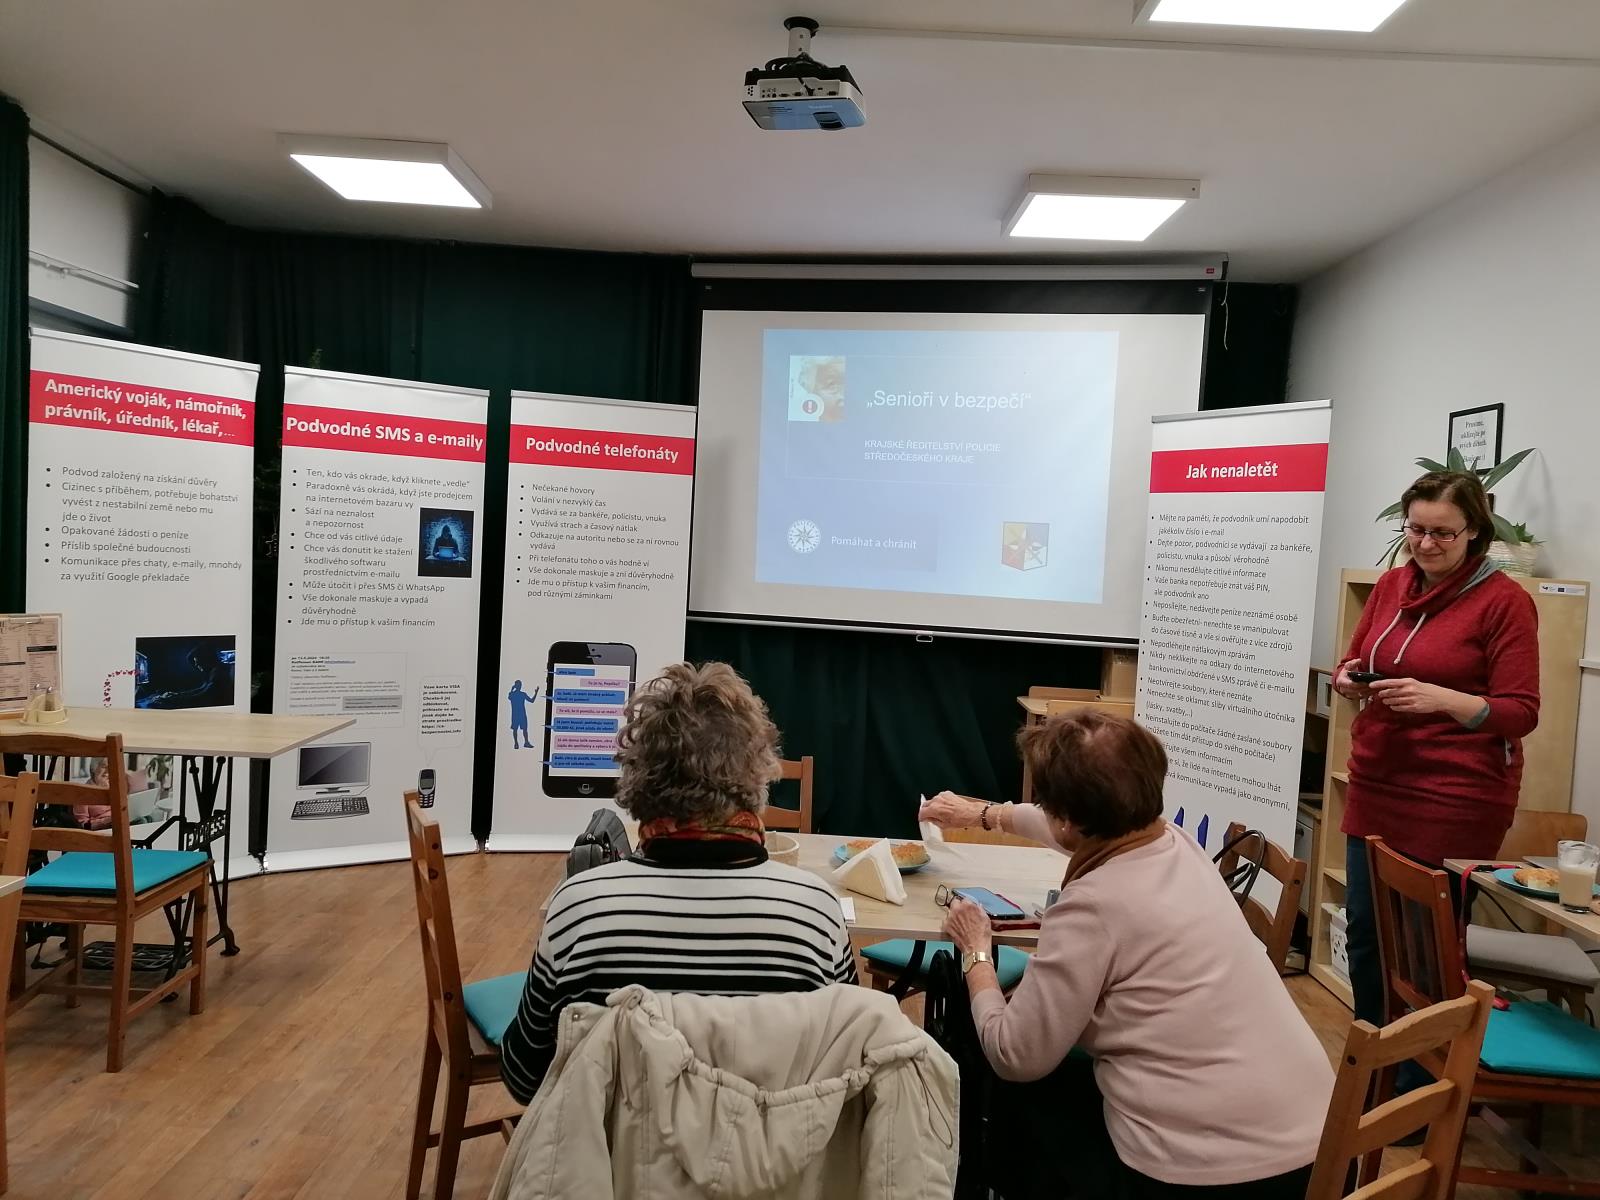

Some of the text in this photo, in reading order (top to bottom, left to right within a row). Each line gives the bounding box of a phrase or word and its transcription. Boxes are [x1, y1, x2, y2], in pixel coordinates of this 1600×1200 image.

[45, 379, 247, 419] Americký voják, námořník,
[940, 396, 949, 407] v
[45, 405, 111, 423] právník,
[116, 412, 178, 432] úředník,
[287, 417, 483, 451] Podvodné SMS a e-maily
[526, 437, 679, 463] Podvodné telefonáty
[865, 439, 1001, 452] KRAJSKÉ ŘEDITELSTVÍ POLICIE
[864, 451, 974, 464] STŘEDOČESKÉHO KRAJE
[307, 469, 324, 478] Ten,
[327, 469, 342, 478] kdo
[345, 471, 357, 480] vás
[360, 473, 389, 482] okrade,
[392, 474, 409, 484] když
[412, 475, 441, 485] kliknete
[1186, 462, 1278, 479] Jak nenaletět
[63, 467, 217, 488] Podvod založený na získání důvěry
[62, 482, 95, 492] Cizinec
[106, 486, 151, 497] příběhem,
[155, 489, 197, 501] potřebuje
[200, 492, 239, 502] bohatství
[306, 482, 473, 501] Paradoxně vás okrádá, když jste prodejcem
[63, 498, 92, 508] vyvést
[103, 500, 147, 510] nestabilní
[150, 503, 172, 511] země
[176, 503, 197, 513] nebo
[319, 495, 373, 505] internetovém
[376, 499, 402, 507] bazaru
[337, 509, 374, 518] neznalost
[62, 526, 114, 537] Opakované
[118, 528, 149, 538] žádosti
[161, 530, 189, 539] peníze
[305, 531, 403, 543] Chce od vás citlivé údaje
[62, 542, 190, 554] Příslib společné budoucnosti
[831, 535, 916, 549] Pomáhat a chránit
[61, 557, 242, 570] Komunikace přes chaty, e-maily, mnohdy
[304, 557, 386, 567] škodlivého softwaru
[74, 572, 104, 582] využití
[107, 573, 139, 582] Google
[142, 573, 189, 583] překladače
[304, 569, 400, 578] prostřednictvím e-mailu
[302, 606, 356, 616] důvěryhodně
